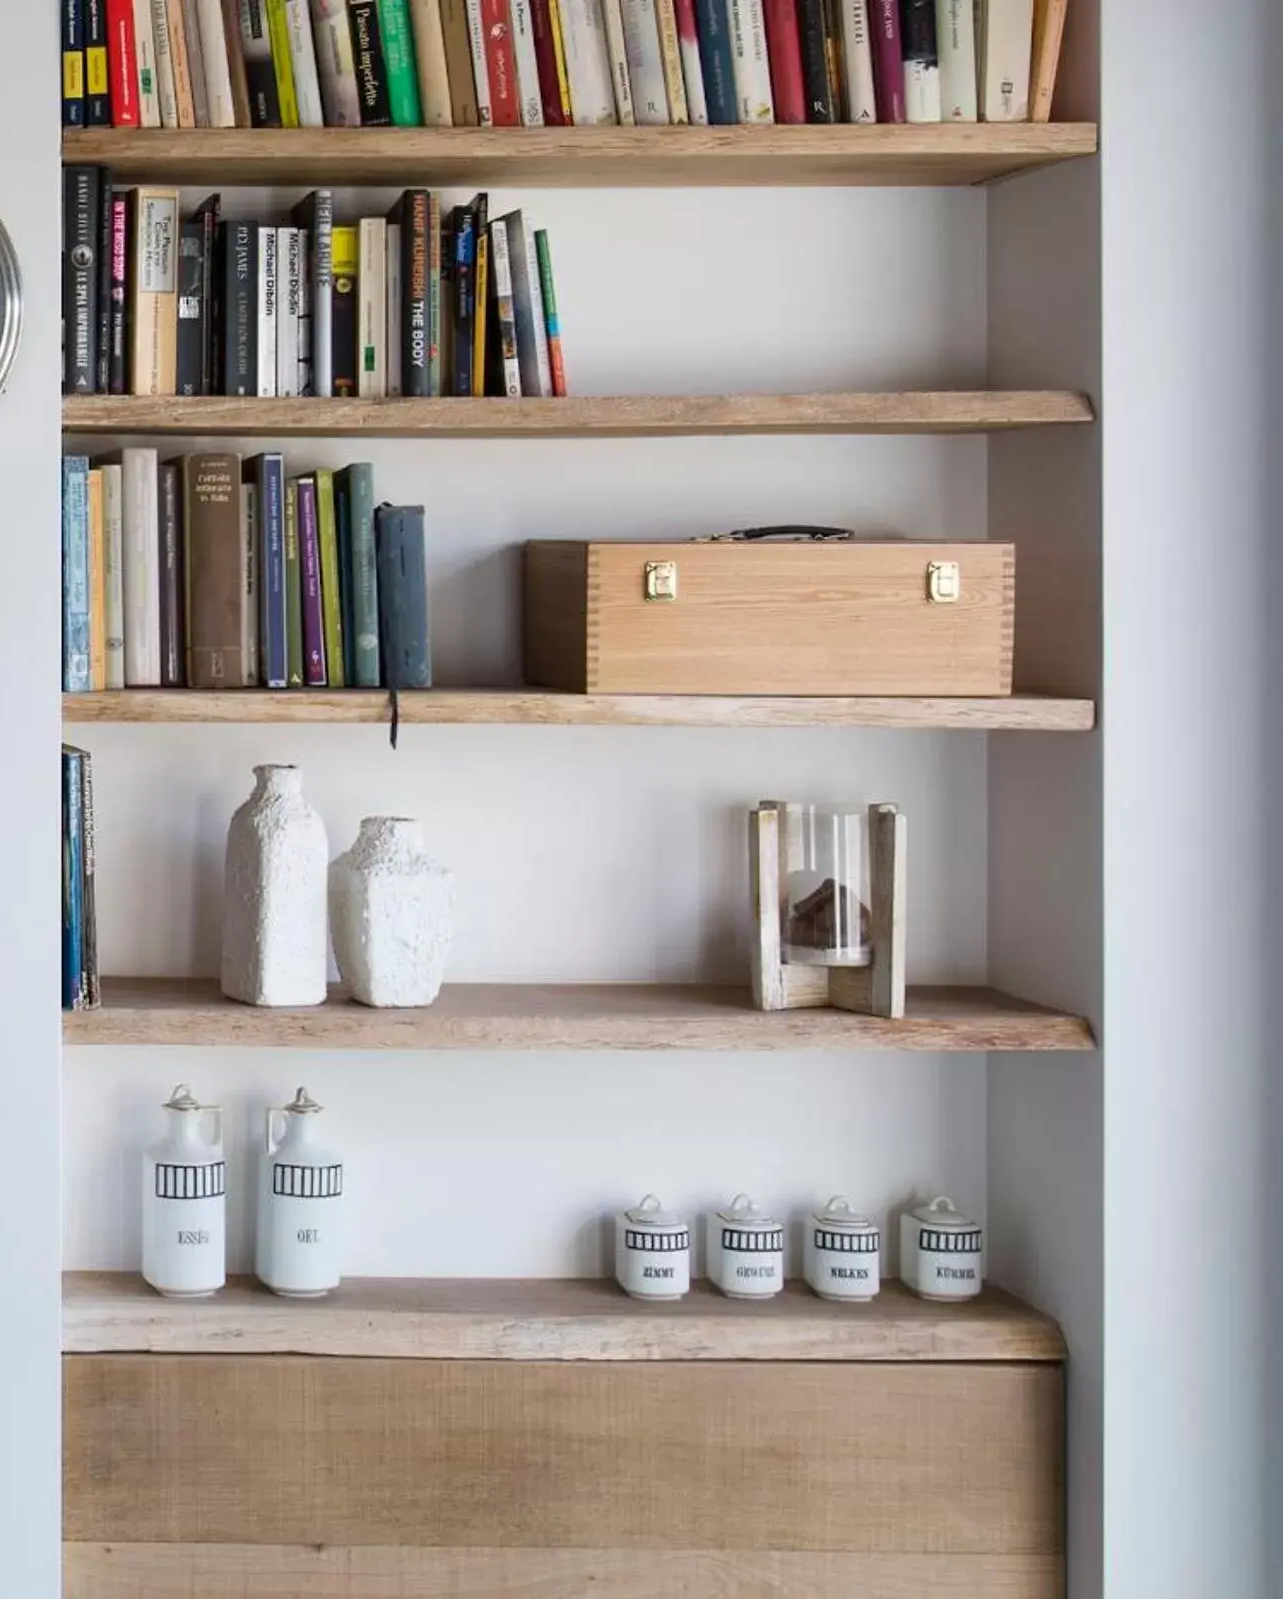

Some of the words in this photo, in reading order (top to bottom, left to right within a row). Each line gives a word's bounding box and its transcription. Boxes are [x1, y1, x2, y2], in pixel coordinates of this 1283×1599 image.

[413, 194, 424, 234] HANIF
[265, 233, 275, 278] Michael
[289, 233, 298, 277] Michael
[413, 237, 425, 299] KUREISHI
[265, 280, 275, 316] Dibdin
[288, 279, 298, 315] Dibdin
[412, 300, 424, 326] THE
[412, 329, 425, 367] BODY
